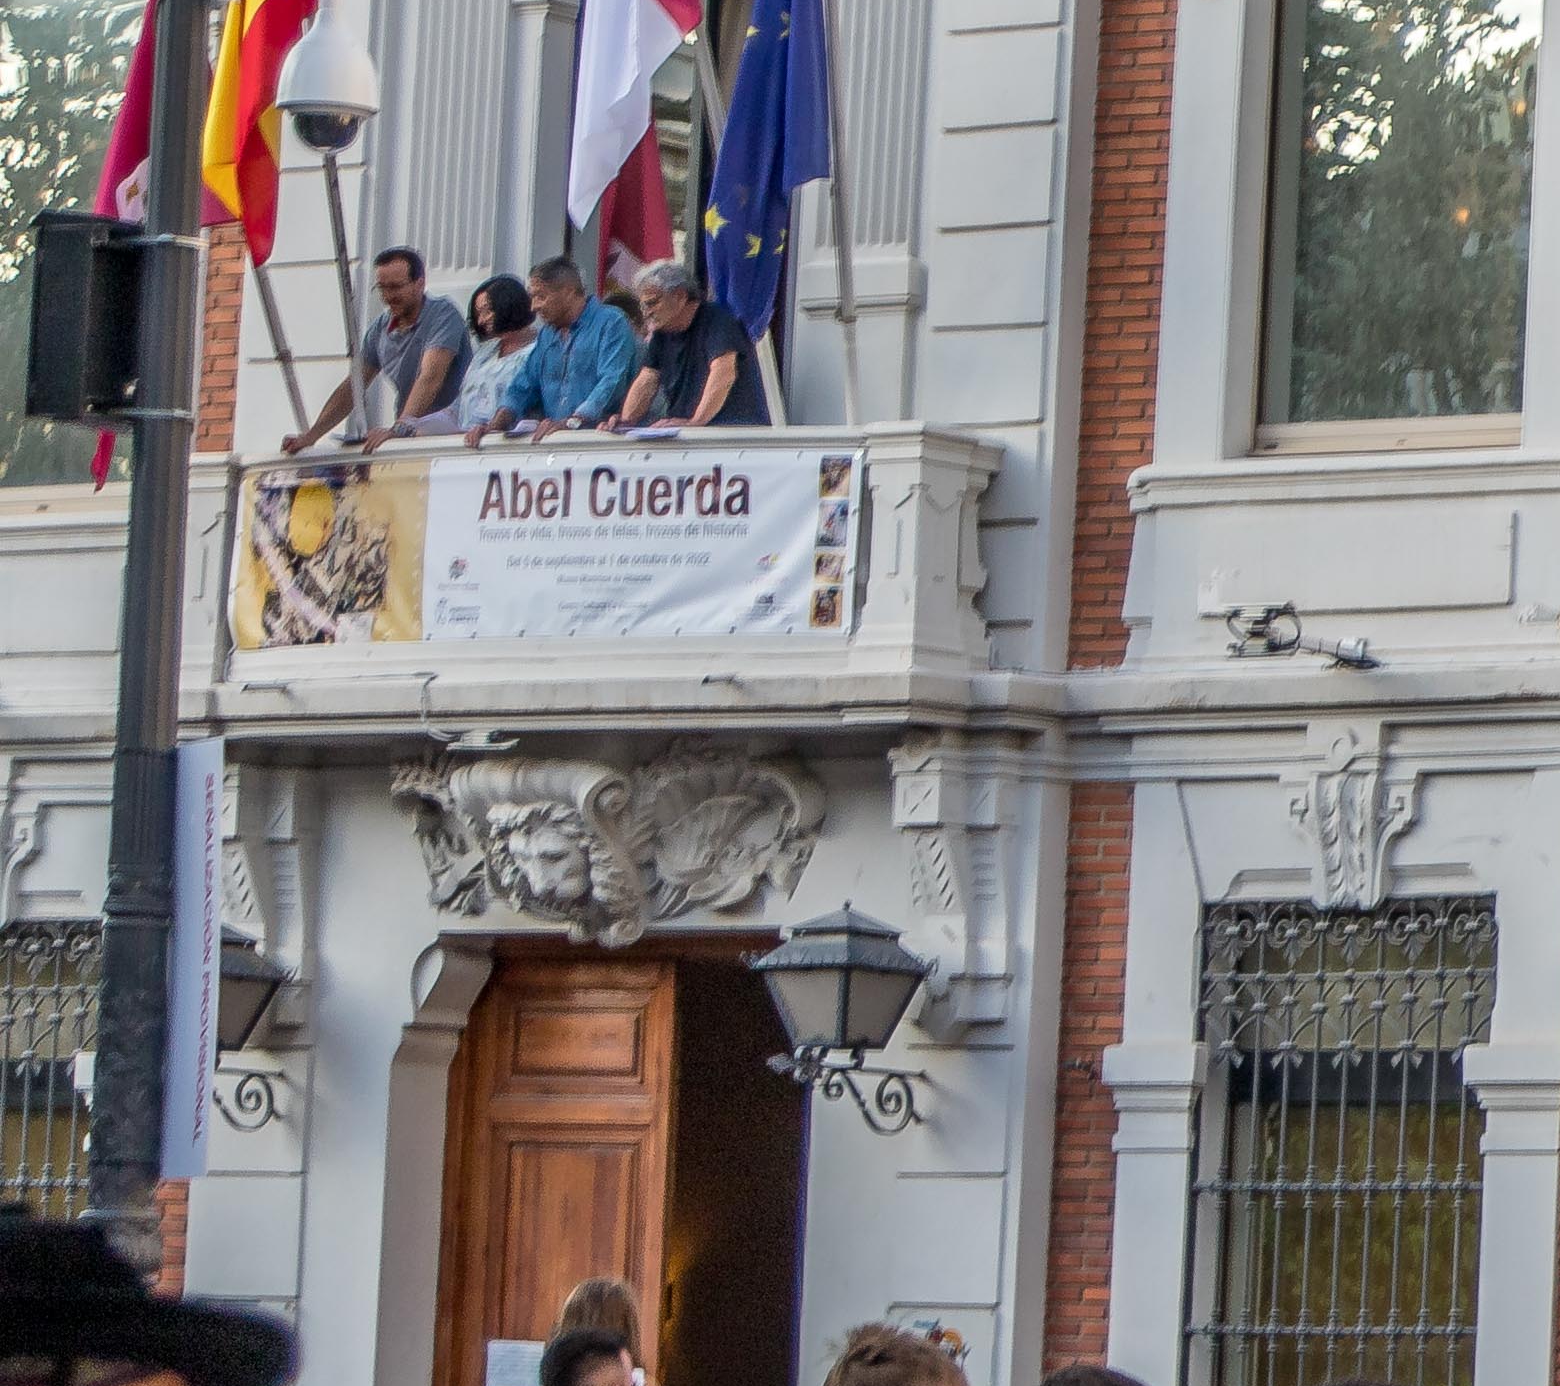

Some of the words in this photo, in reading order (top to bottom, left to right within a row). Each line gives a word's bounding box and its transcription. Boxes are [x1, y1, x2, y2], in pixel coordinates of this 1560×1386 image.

[478, 466, 573, 521] Abel
[588, 464, 752, 518] Cuerda
[193, 971, 211, 1147] PROVISIONAL
